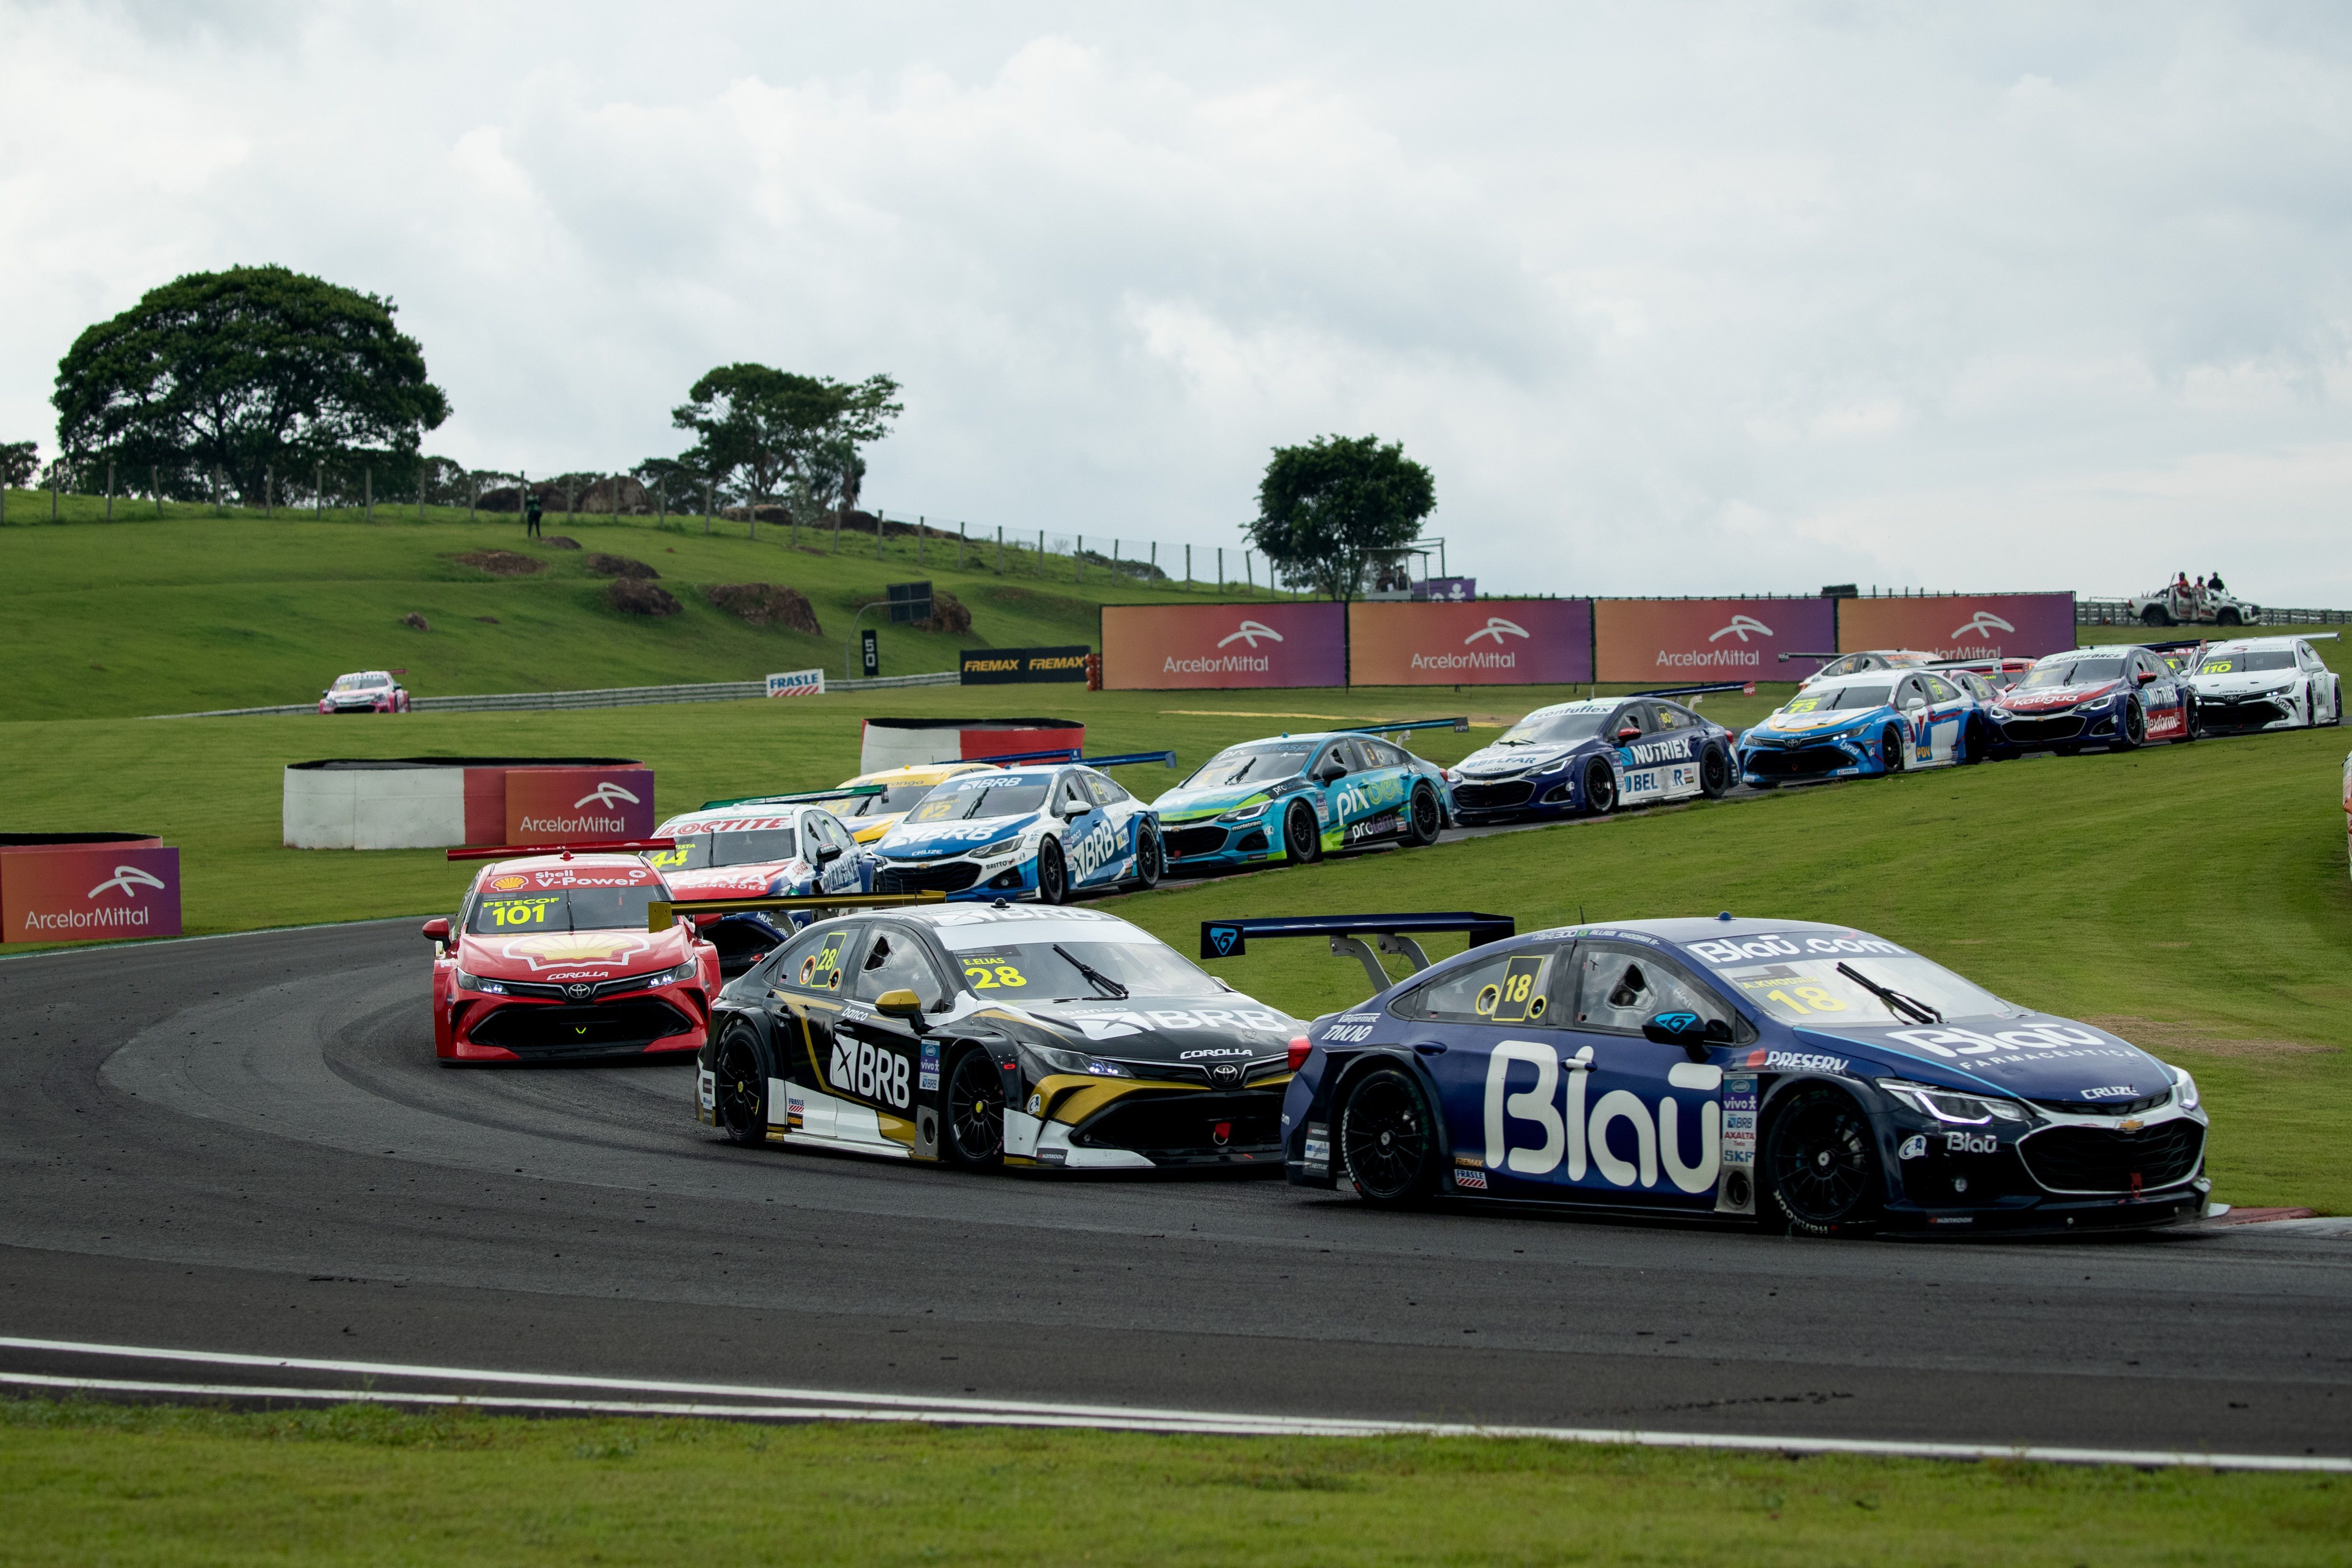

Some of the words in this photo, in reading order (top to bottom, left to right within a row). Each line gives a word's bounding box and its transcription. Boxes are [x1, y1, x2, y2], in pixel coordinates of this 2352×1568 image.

[865, 639, 875, 669] 50
[1656, 649, 1760, 667] ArcelorMittal
[1903, 646, 2001, 660] lorMittal
[2055, 653, 2123, 662] AUTOFORCE
[964, 659, 1020, 672] FREMAX
[1029, 656, 1085, 669] FREMAX
[1163, 655, 1269, 674] ArcelorMittal
[1411, 652, 1515, 669] ArcelorMittal
[2202, 663, 2232, 675] 110
[1932, 684, 1942, 695] 73
[2145, 684, 2179, 705] NUTRIEX
[1788, 701, 1818, 714] 73
[2275, 696, 2291, 711] Lynd
[1537, 705, 1612, 718] contuflex
[1660, 712, 1672, 724] 80
[2147, 714, 2177, 732] lexform
[1630, 739, 1692, 764] NUTRIEX
[1839, 739, 1860, 756] Lynd
[1916, 745, 1931, 758] PDV
[1477, 757, 1537, 767] BELFAR
[977, 777, 1023, 789] BRB
[1634, 769, 1684, 792] BELR
[1091, 782, 1103, 795] 12
[919, 804, 952, 819] 12
[519, 815, 625, 834] ArcelorMittal
[658, 818, 790, 836] LOCTITE
[1232, 820, 1262, 831] montebravo
[1352, 814, 1395, 844] prolam
[916, 827, 1000, 842] BRB
[1071, 829, 1082, 844] anco
[1084, 820, 1114, 876] BRB
[651, 850, 688, 868] 44
[986, 860, 1008, 870] BRITTO
[535, 869, 574, 879] Shell
[536, 876, 639, 888] V-Power
[483, 897, 560, 908] PETECOF
[24, 905, 149, 930] ArcelorMittal
[492, 904, 546, 926] 101
[993, 907, 1103, 921] BRB
[1617, 932, 1652, 943] KHODAIR
[816, 948, 837, 971] 28
[546, 971, 608, 981] COROLLA
[965, 966, 1027, 989] 28
[1742, 977, 1822, 989] A.KHODAIR
[1505, 974, 1532, 1003] 18
[1766, 987, 1848, 1015] 18
[841, 1005, 868, 1022] banco
[1059, 1006, 1128, 1016] banco
[1144, 1010, 1287, 1033] BRB
[1320, 1025, 1373, 1042] TAKAO
[1180, 1048, 1253, 1060] COROLLA
[1764, 1051, 1848, 1070] PRESERV
[1960, 1046, 2140, 1070] FARMACÊUTICA
[921, 1059, 934, 1070] vivo
[857, 1042, 910, 1109] BRB
[927, 1079, 937, 1089] BRB
[2081, 1085, 2140, 1099] CRUZE
[1724, 1097, 1748, 1109] vivo
[788, 1116, 802, 1125] FREMAX
[1737, 1117, 1753, 1129] BRB
[1724, 1131, 1755, 1140] AXALTA
[1455, 1157, 1484, 1167] FREMAX
[1724, 1150, 1755, 1162] SKF
